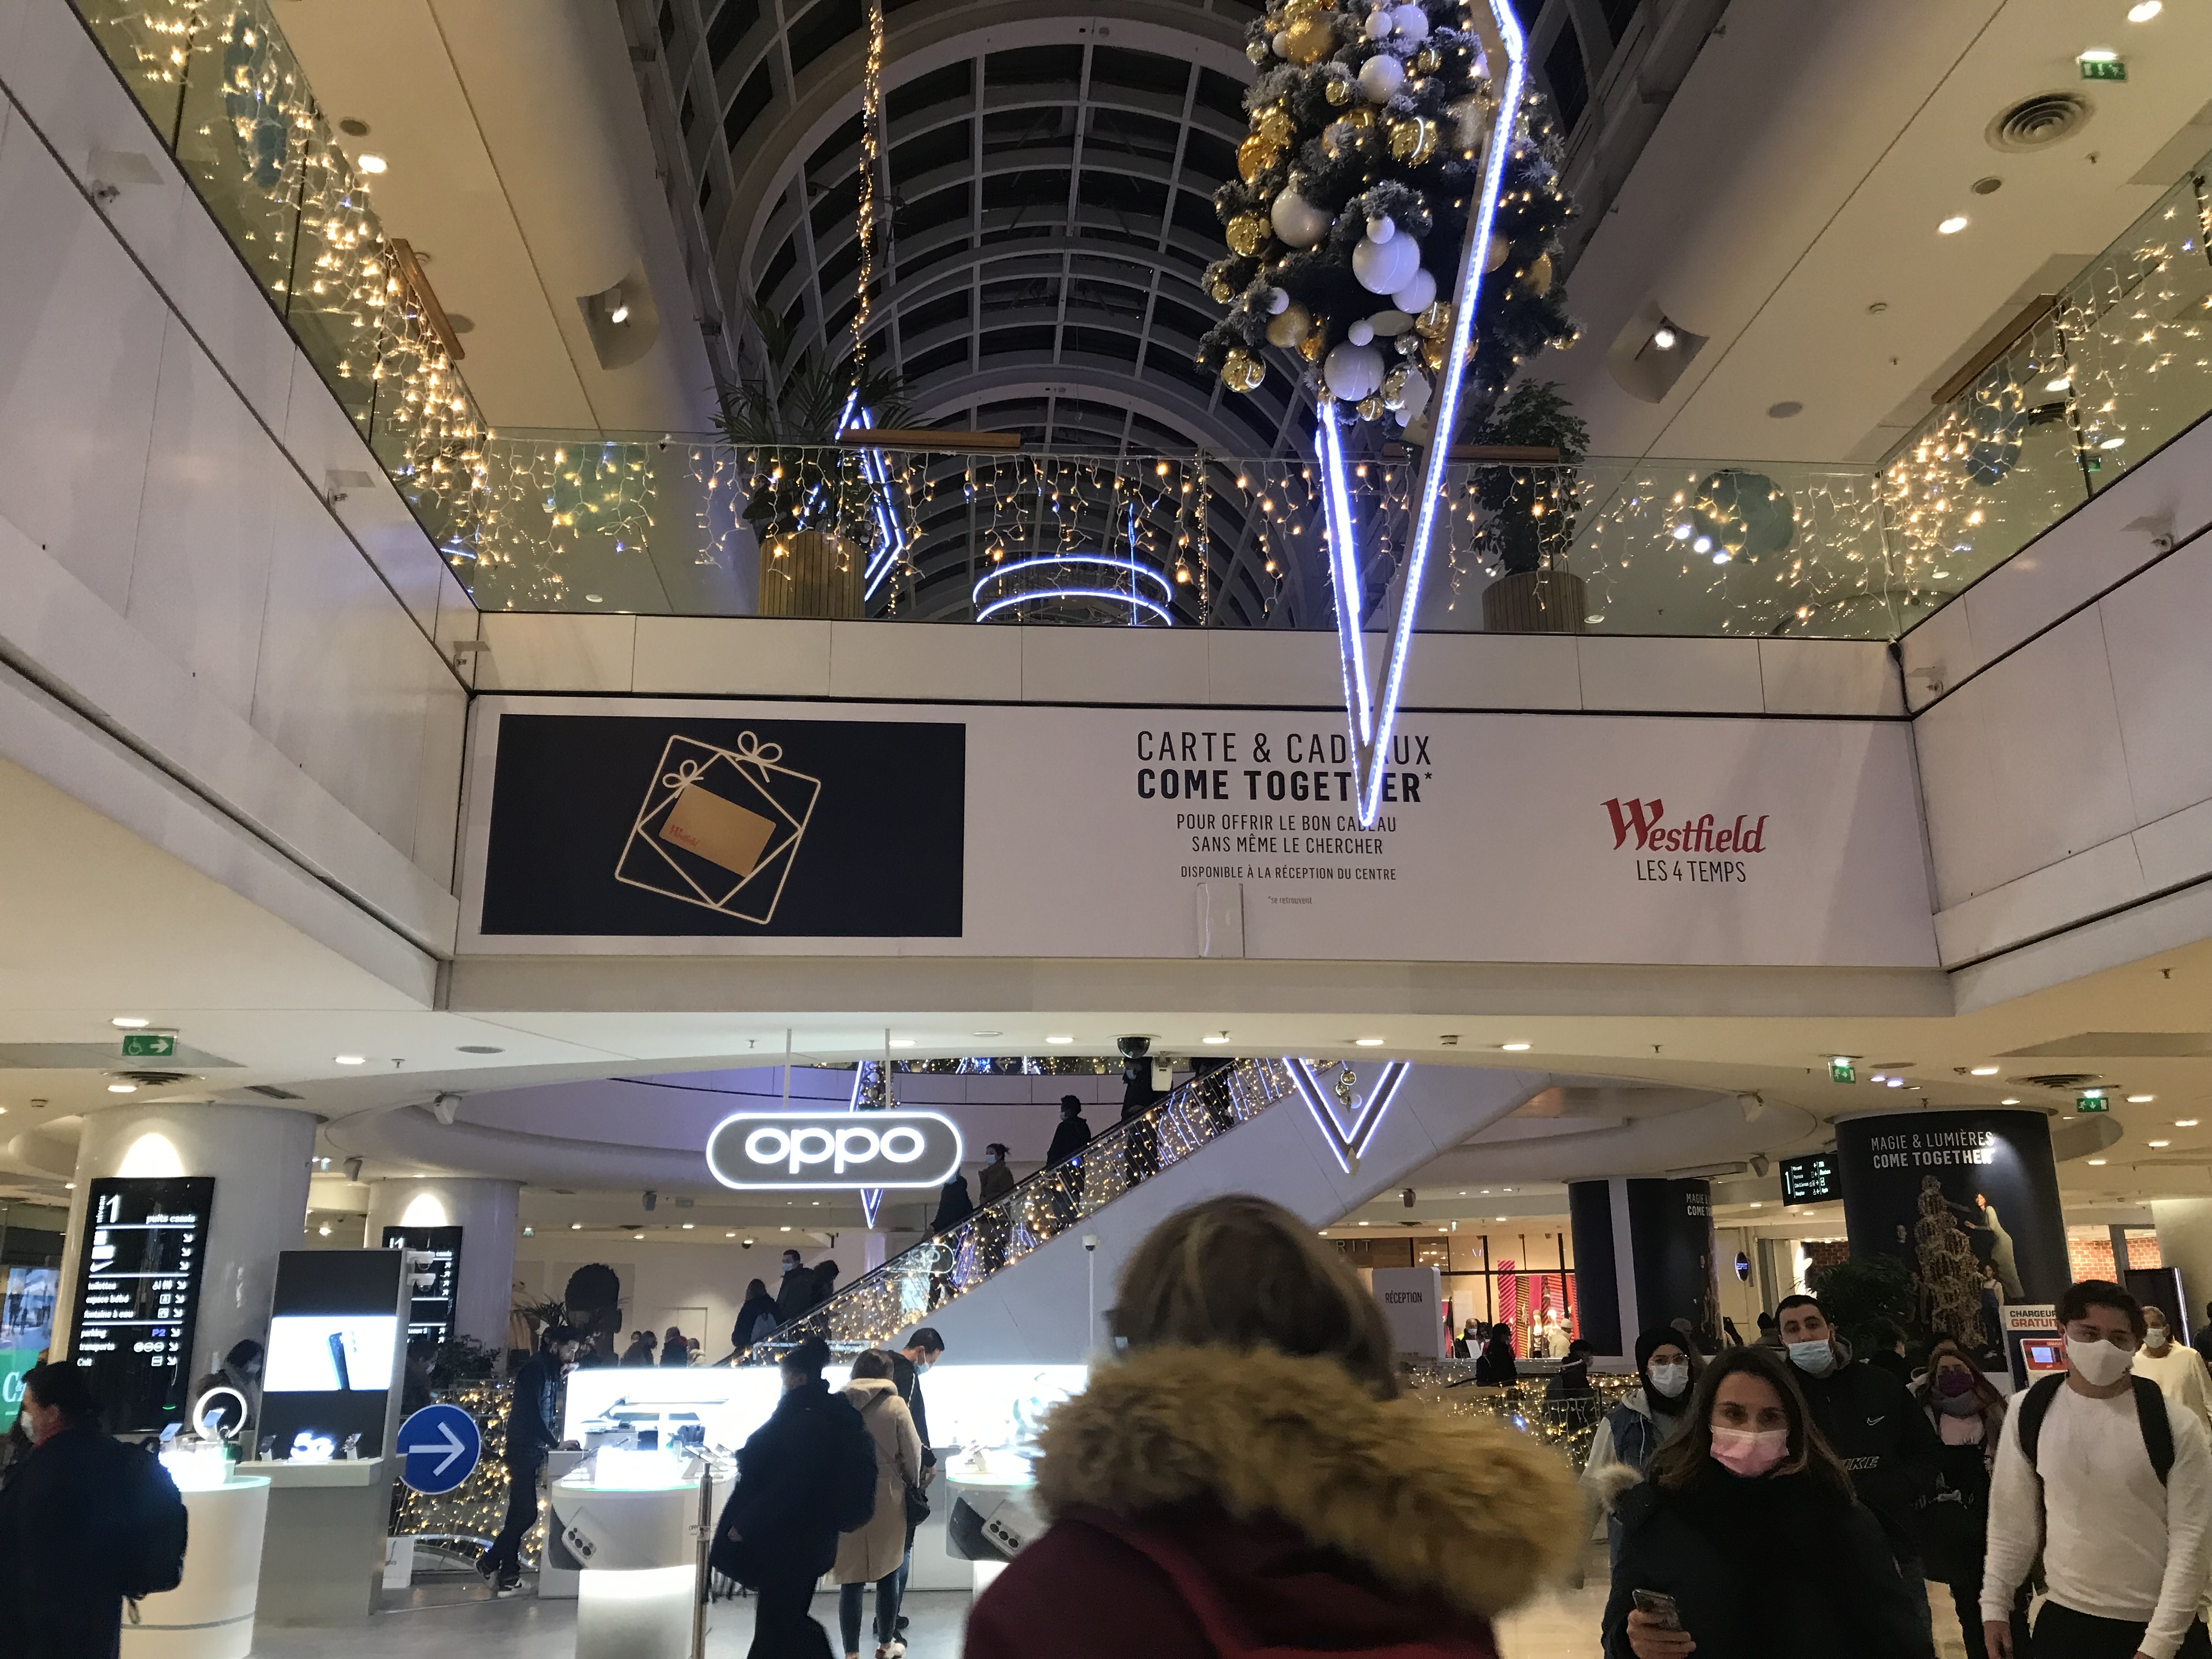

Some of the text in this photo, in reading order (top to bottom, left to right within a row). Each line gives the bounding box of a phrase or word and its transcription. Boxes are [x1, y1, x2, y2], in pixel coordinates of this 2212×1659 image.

[1137, 731, 1431, 765] CARTE & CADUX
[1137, 768, 1432, 803] COME TOGETER
[1177, 814, 1215, 830] POUR
[1222, 814, 1273, 830] OFFRIR
[1279, 815, 1296, 831] LE
[1302, 815, 1330, 831] BON
[1600, 798, 1770, 853] Westfield
[1192, 833, 1383, 854] SANS MÊME LE CHERCHER
[1181, 864, 1396, 881] DISPONIBLE À LA RÉCEPTION DU CENTRE
[1637, 860, 1746, 883] LES 4 TEMPS
[1871, 1129, 1995, 1151] MAGIE & LUMIÈRES
[745, 1127, 925, 1174] oppo
[1873, 1153, 1909, 1169] COME
[1686, 1193, 1705, 1204] MAGIE
[106, 1194, 120, 1223] 1
[1687, 1205, 1705, 1216] COME
[170, 1214, 196, 1223] cassis
[88, 1281, 117, 1290] toilettes
[1385, 1290, 1423, 1304] RÉCEPTION
[81, 1328, 166, 1339] parking P2
[1843, 1456, 1880, 1471] IKE
